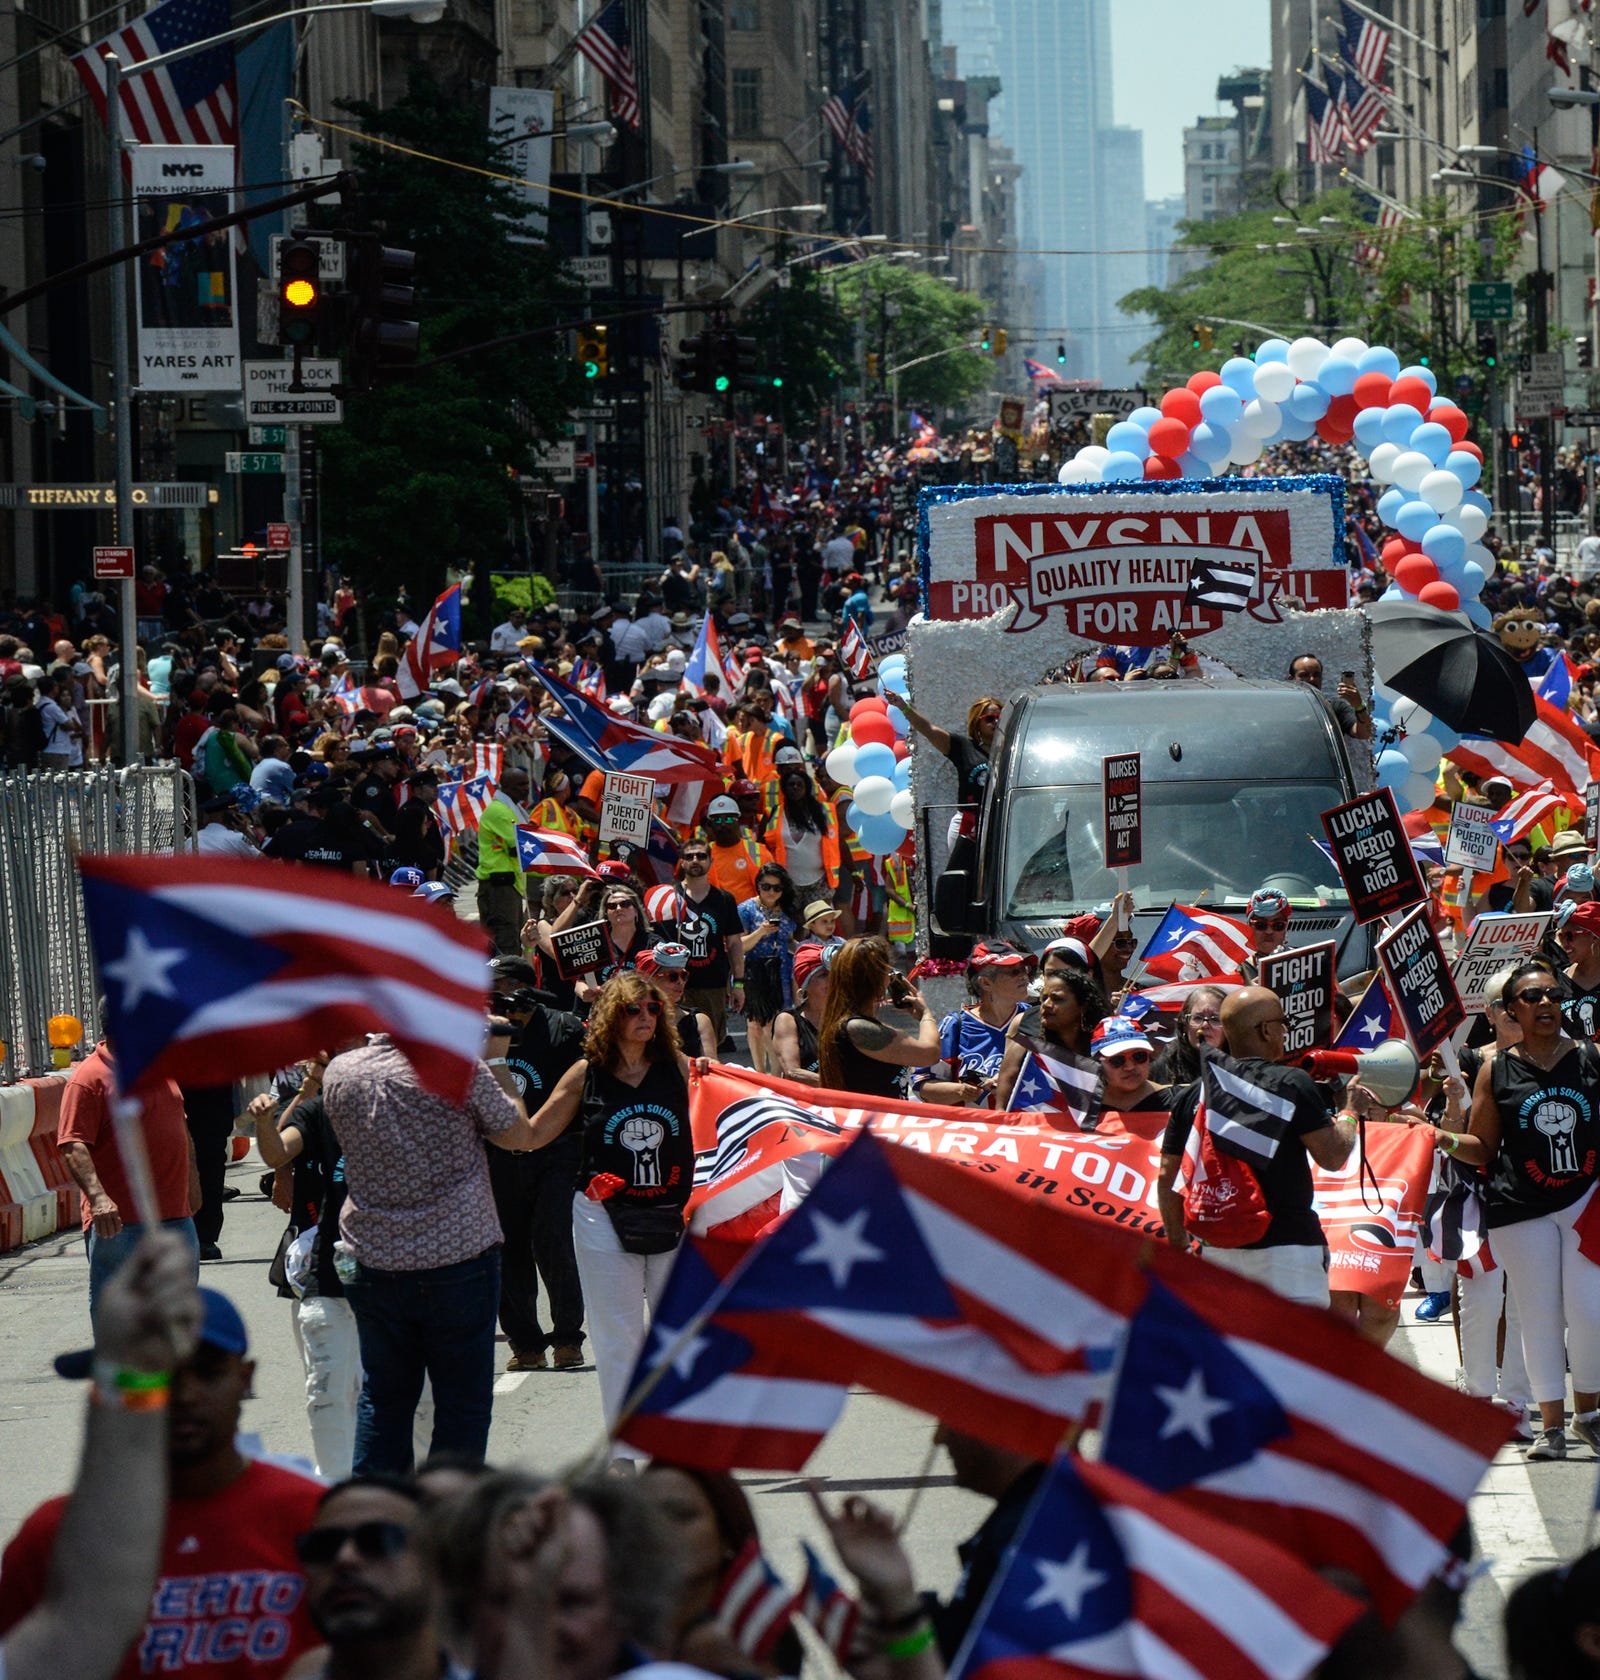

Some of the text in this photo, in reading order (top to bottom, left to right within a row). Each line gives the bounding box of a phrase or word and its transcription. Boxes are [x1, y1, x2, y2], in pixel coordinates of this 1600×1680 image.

[163, 164, 203, 177] NYC
[136, 185, 231, 194] HANS HOFMANN
[318, 258, 339, 272] NLY
[143, 355, 235, 368] YARES ART
[250, 369, 333, 380] DON'T LOCK
[267, 382, 290, 393] THE
[250, 402, 278, 413] FINE
[296, 401, 337, 412] POINTS
[1057, 391, 1136, 415] DEFEND
[271, 429, 285, 442] 57
[241, 456, 248, 468] E
[252, 456, 267, 470] 57
[28, 488, 149, 504] TIFFANY & O.
[97, 549, 129, 558] NO STANDING
[1036, 559, 1122, 597] QUALITY
[1077, 599, 1211, 634] FOR ALL
[1108, 758, 1138, 780] NURSES
[609, 776, 649, 798] FIGHT
[606, 803, 645, 821] PUERTO
[1108, 797, 1118, 813] LA
[611, 817, 636, 832] RICO
[1109, 812, 1139, 831] PROMESA
[1329, 798, 1390, 839] LUCHA
[1117, 830, 1131, 849] ACT
[1355, 825, 1374, 841] por
[1455, 828, 1494, 846] PUERTO
[1342, 829, 1397, 866] PUERTO
[1460, 841, 1486, 857] RICO
[1361, 864, 1400, 895] RICO
[556, 926, 601, 947] LUCHA
[1477, 921, 1541, 945] LUCHA
[561, 938, 602, 958] PUERTO
[1386, 917, 1431, 971] LUCHA
[572, 953, 599, 968] RICO
[1271, 950, 1327, 989] FIGHT
[1399, 950, 1439, 998] PUERTO
[1290, 980, 1307, 996] for
[1280, 986, 1324, 1019] UERTO
[1417, 988, 1446, 1025] RICO
[1283, 1024, 1315, 1052] RICO
[515, 1058, 543, 1090] SOLIDARITY
[1518, 1086, 1592, 1129] NY NURSES IN SOLIDARITY
[603, 1103, 681, 1145] NY NURSES IN SOLIDARITY
[809, 1104, 1040, 1137] ALIDAD
[1583, 1149, 1597, 1176] RICO
[1016, 1168, 1059, 1195] in
[152, 1567, 306, 1620] ERTO
[137, 1613, 293, 1676] RICO
